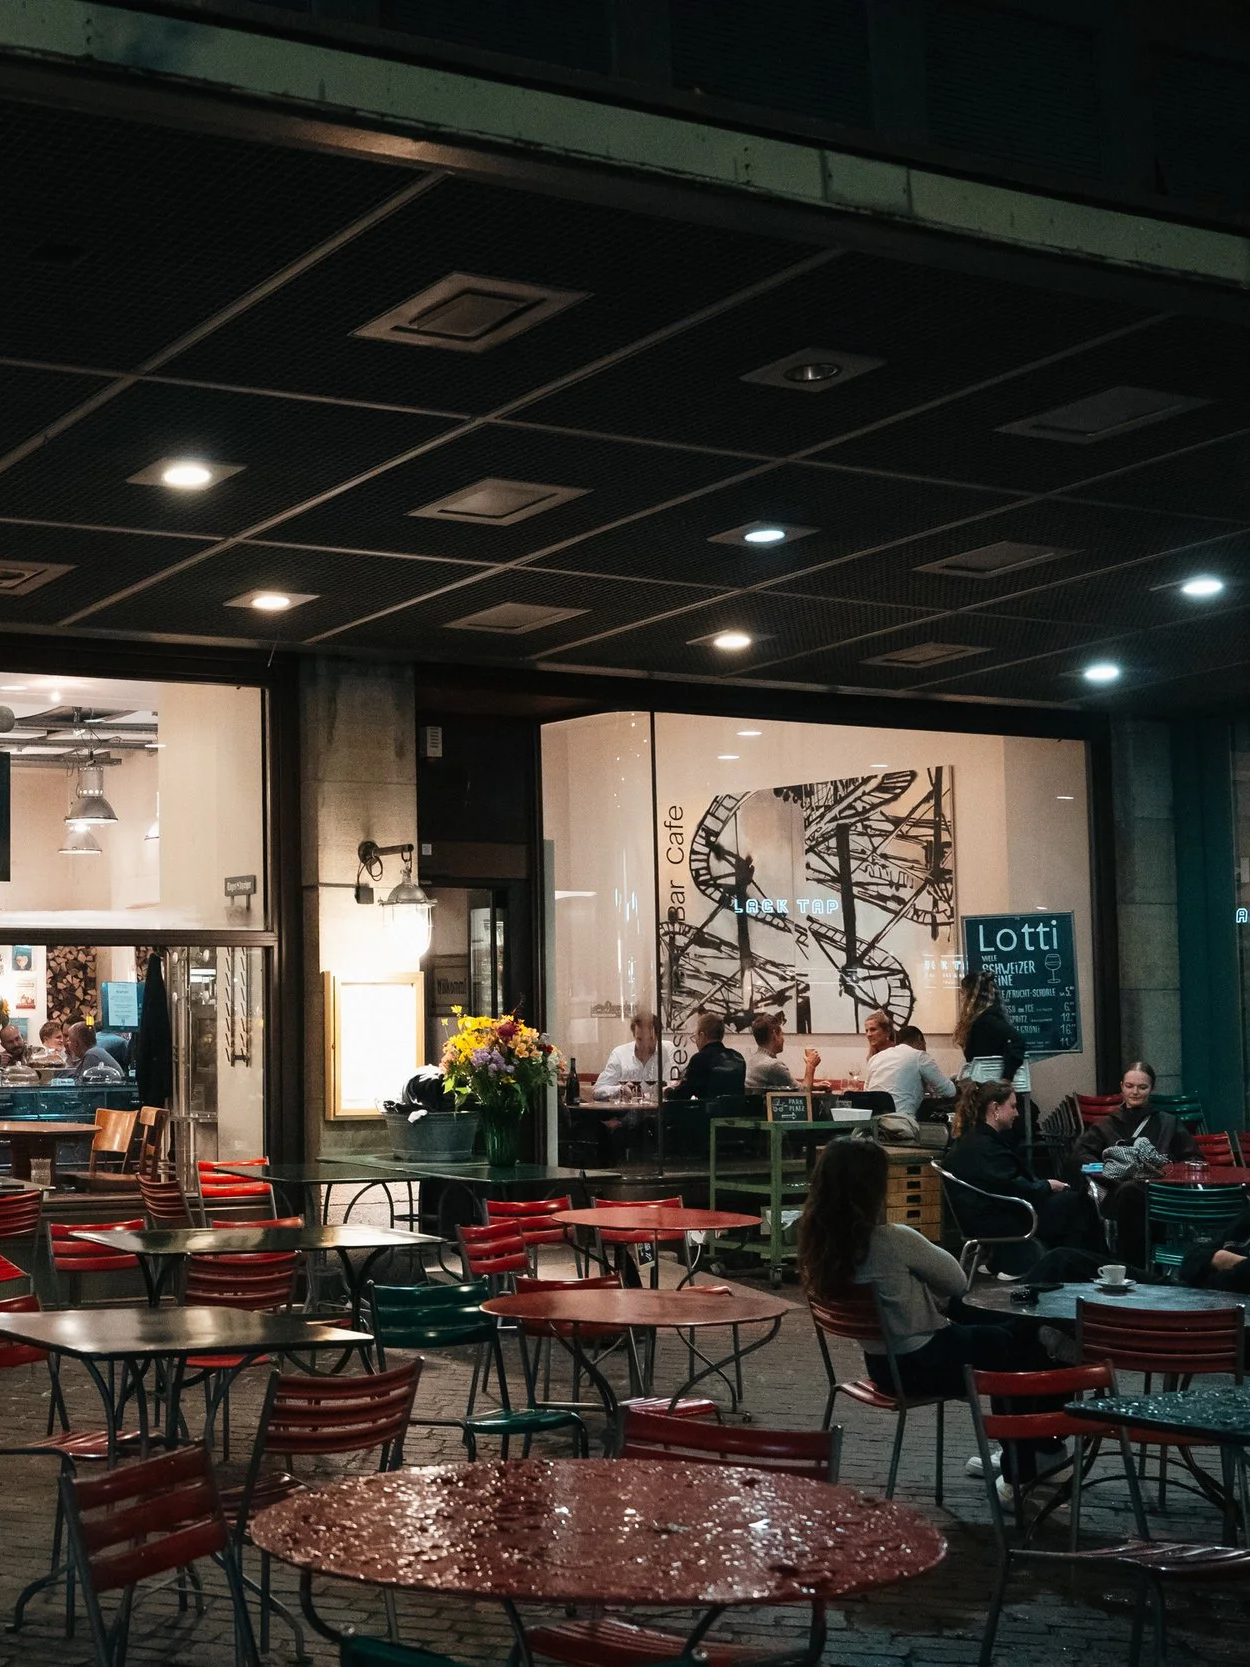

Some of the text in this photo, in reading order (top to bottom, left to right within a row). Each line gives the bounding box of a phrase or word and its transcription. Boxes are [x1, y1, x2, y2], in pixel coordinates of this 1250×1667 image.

[664, 805, 685, 865] Cafe
[796, 899, 839, 915] TAP
[978, 920, 1058, 952] Lotti
